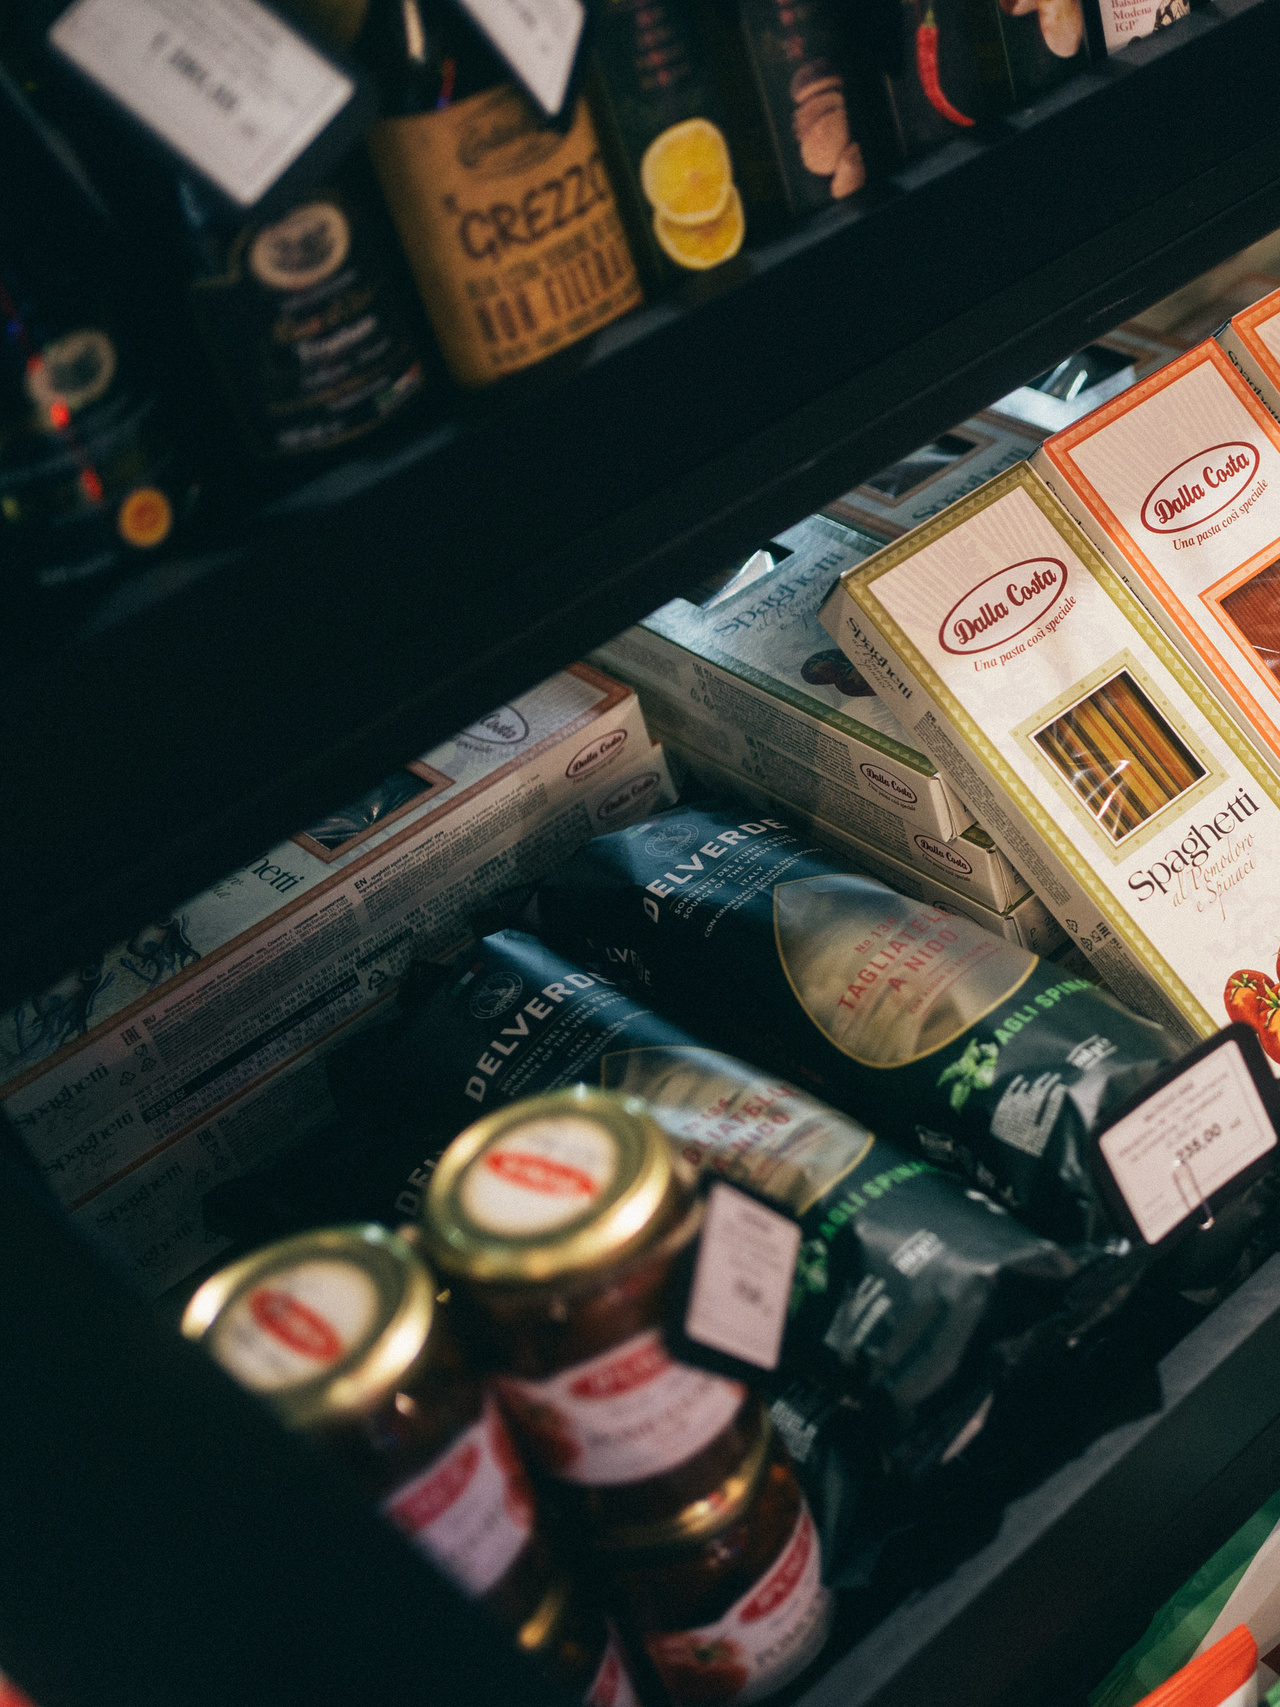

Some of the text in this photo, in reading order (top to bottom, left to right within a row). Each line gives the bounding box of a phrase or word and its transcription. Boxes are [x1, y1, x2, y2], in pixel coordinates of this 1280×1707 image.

[1113, 7, 1152, 20] Modena
[1153, 452, 1250, 525] Dalla Costa
[1172, 478, 1269, 551] Una pasta così speciale
[953, 569, 1057, 645] Dalla Costa
[973, 595, 1077, 672] Una pasta così speciale
[846, 617, 913, 699] Spaghetti
[866, 767, 913, 800] Dalla Costa
[643, 818, 789, 924] DELVERDE
[674, 833, 791, 915] SORGENTE DEL FIUME VERDE
[739, 865, 764, 887] ITALY
[920, 839, 968, 870] Dalla Costa
[1127, 787, 1260, 902] Spaghetti
[1172, 825, 1256, 907] al Pomodoro
[353, 877, 368, 890] EN
[683, 891, 714, 920] SOURCE
[714, 879, 727, 889] OF
[727, 864, 745, 879] THE
[744, 846, 773, 865] VERDE
[1196, 853, 1257, 922] e Spinaci
[704, 918, 717, 938] CON
[837, 907, 952, 1010] TAGLIATELL
[887, 976, 908, 993] A
[903, 928, 959, 972] NIDO
[501, 1003, 590, 1092] SORGENTE DEL FIUME
[509, 1005, 600, 1096] SOURCE OF THE VERDE
[993, 1004, 1039, 1046] AGLI
[14, 1063, 110, 1127] Spaghetti
[42, 1110, 134, 1177] Spaghetti
